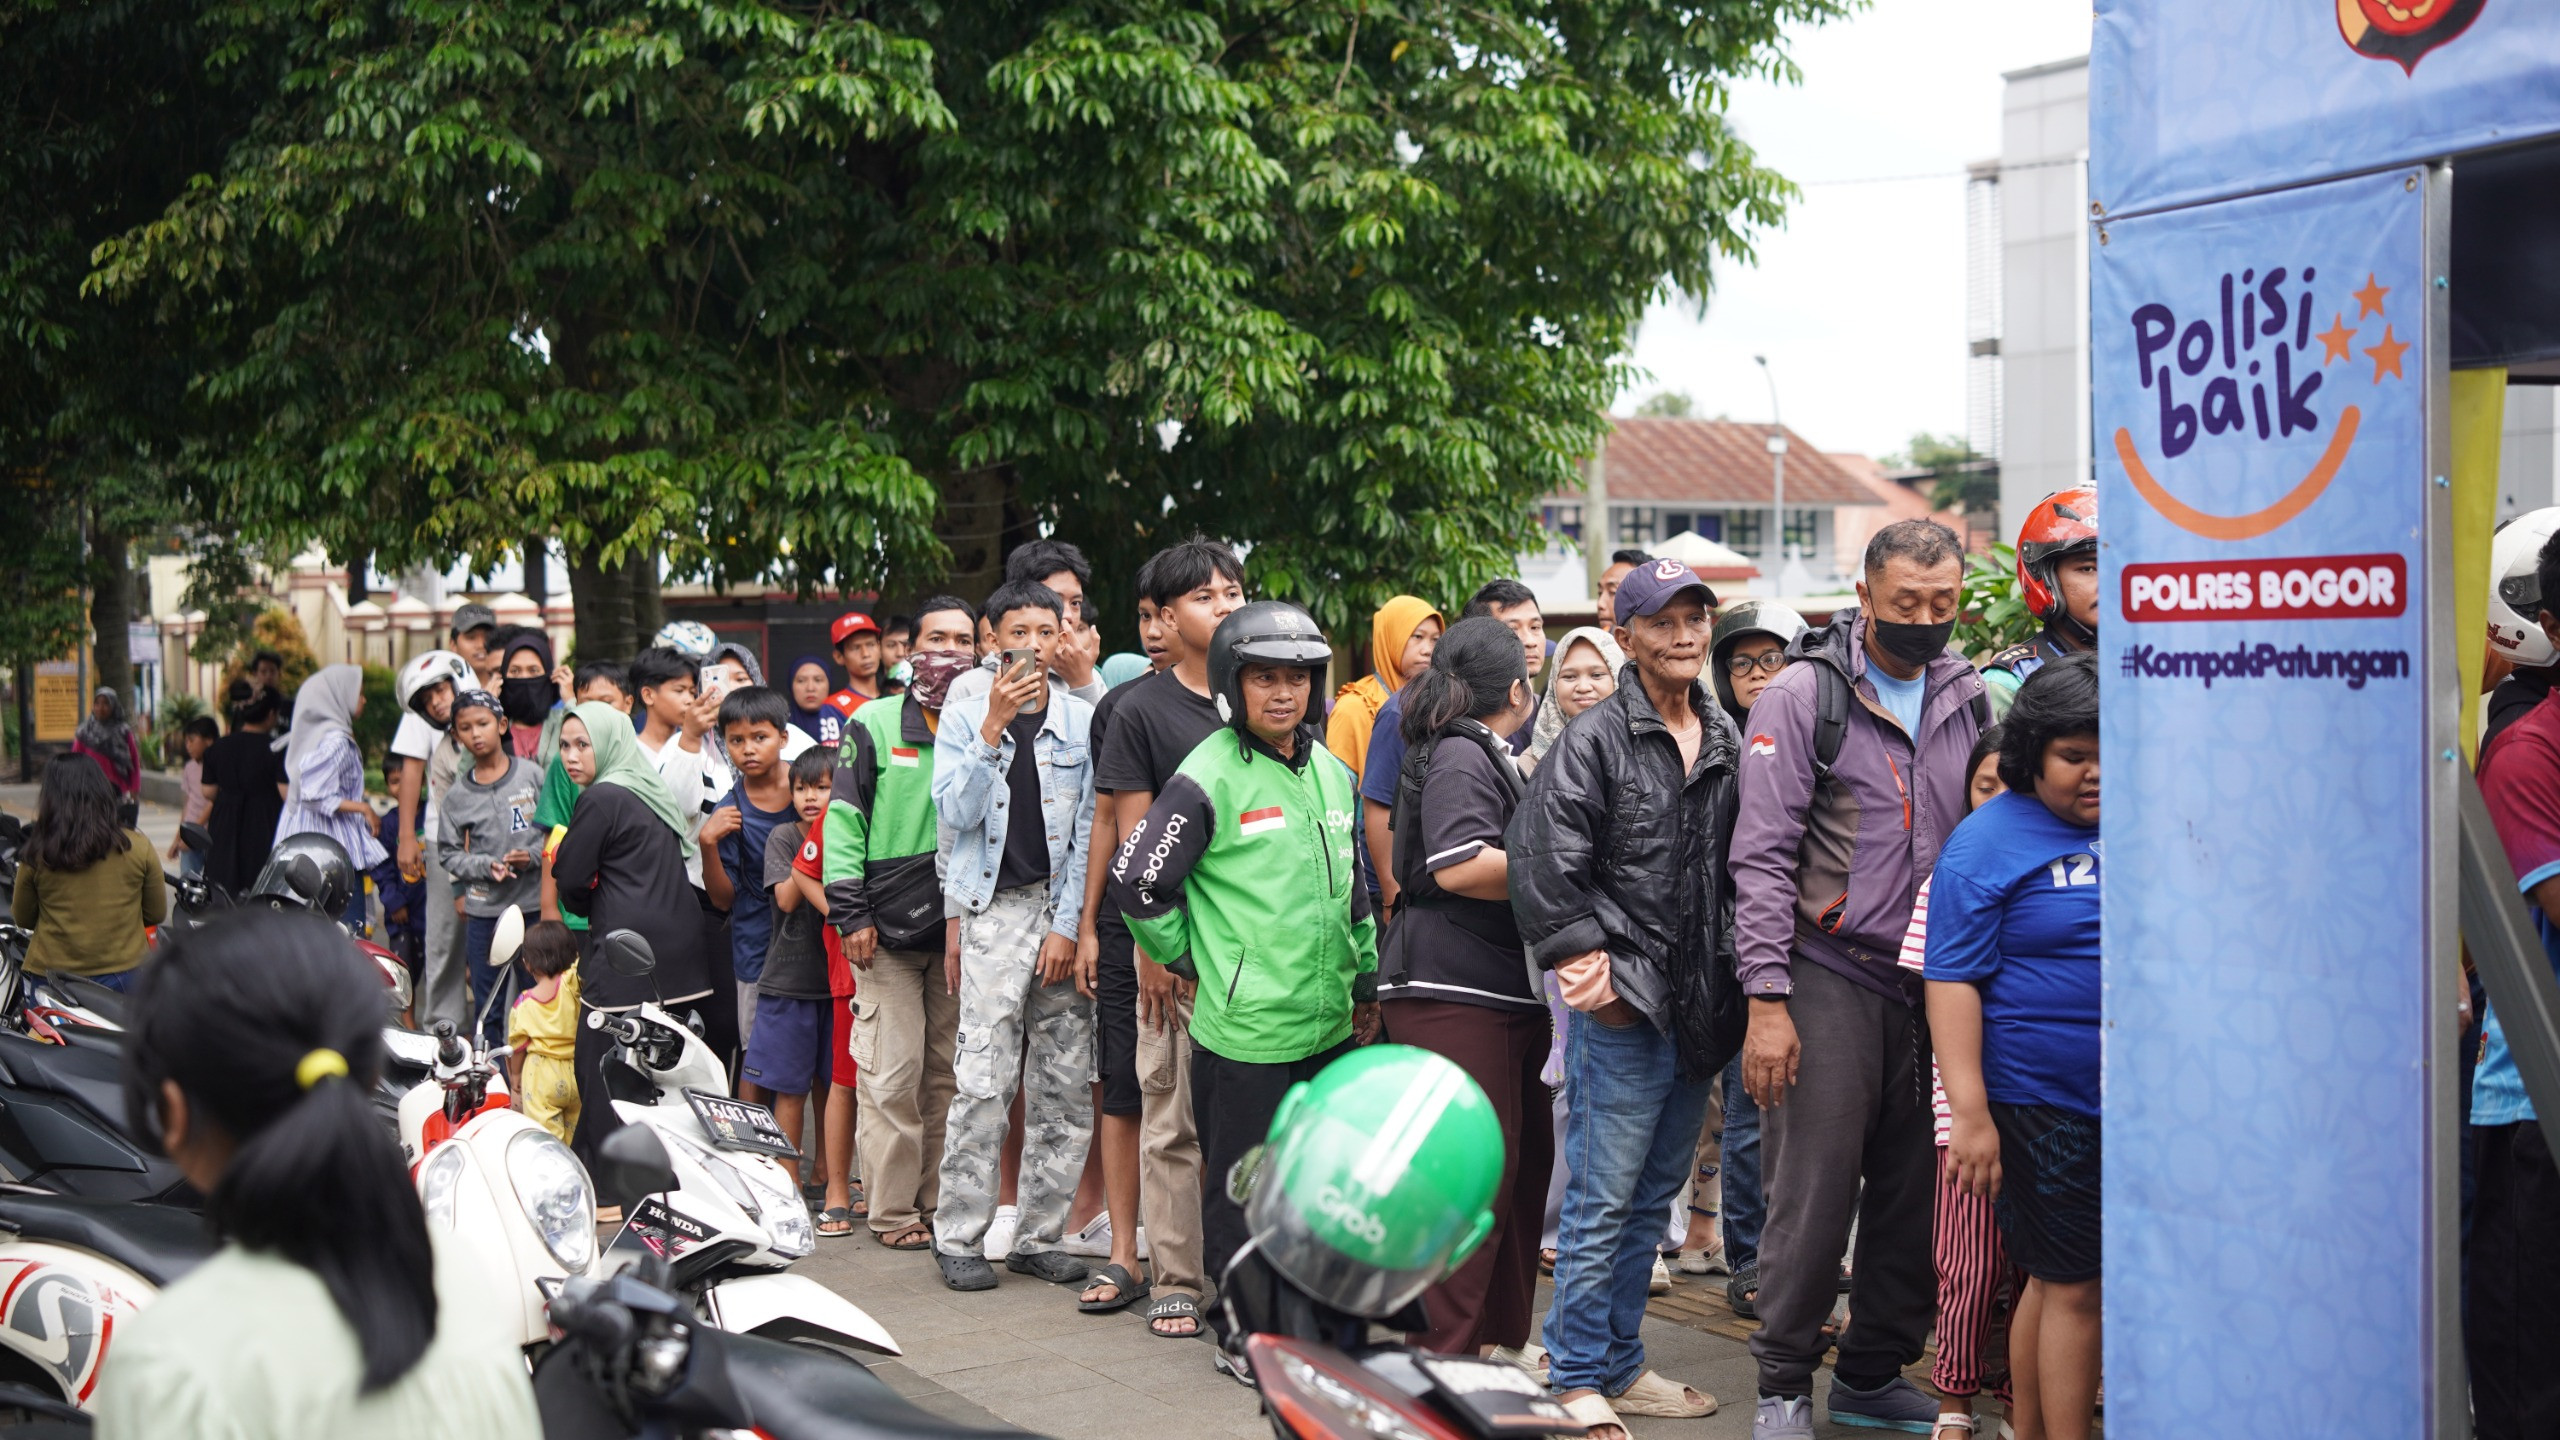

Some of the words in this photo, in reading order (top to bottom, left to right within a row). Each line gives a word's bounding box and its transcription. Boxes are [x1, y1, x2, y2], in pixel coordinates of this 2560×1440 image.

[2131, 267, 2316, 389] Polisi
[2158, 341, 2323, 459] baik
[2130, 571, 2253, 611] POLRES
[2259, 566, 2396, 608] BOGOR
[2120, 640, 2410, 690] #KompakPatungan
[510, 806, 528, 832] A
[2047, 853, 2097, 888] 12
[1317, 1184, 1388, 1246] Grab
[1147, 1300, 1200, 1317] dida
